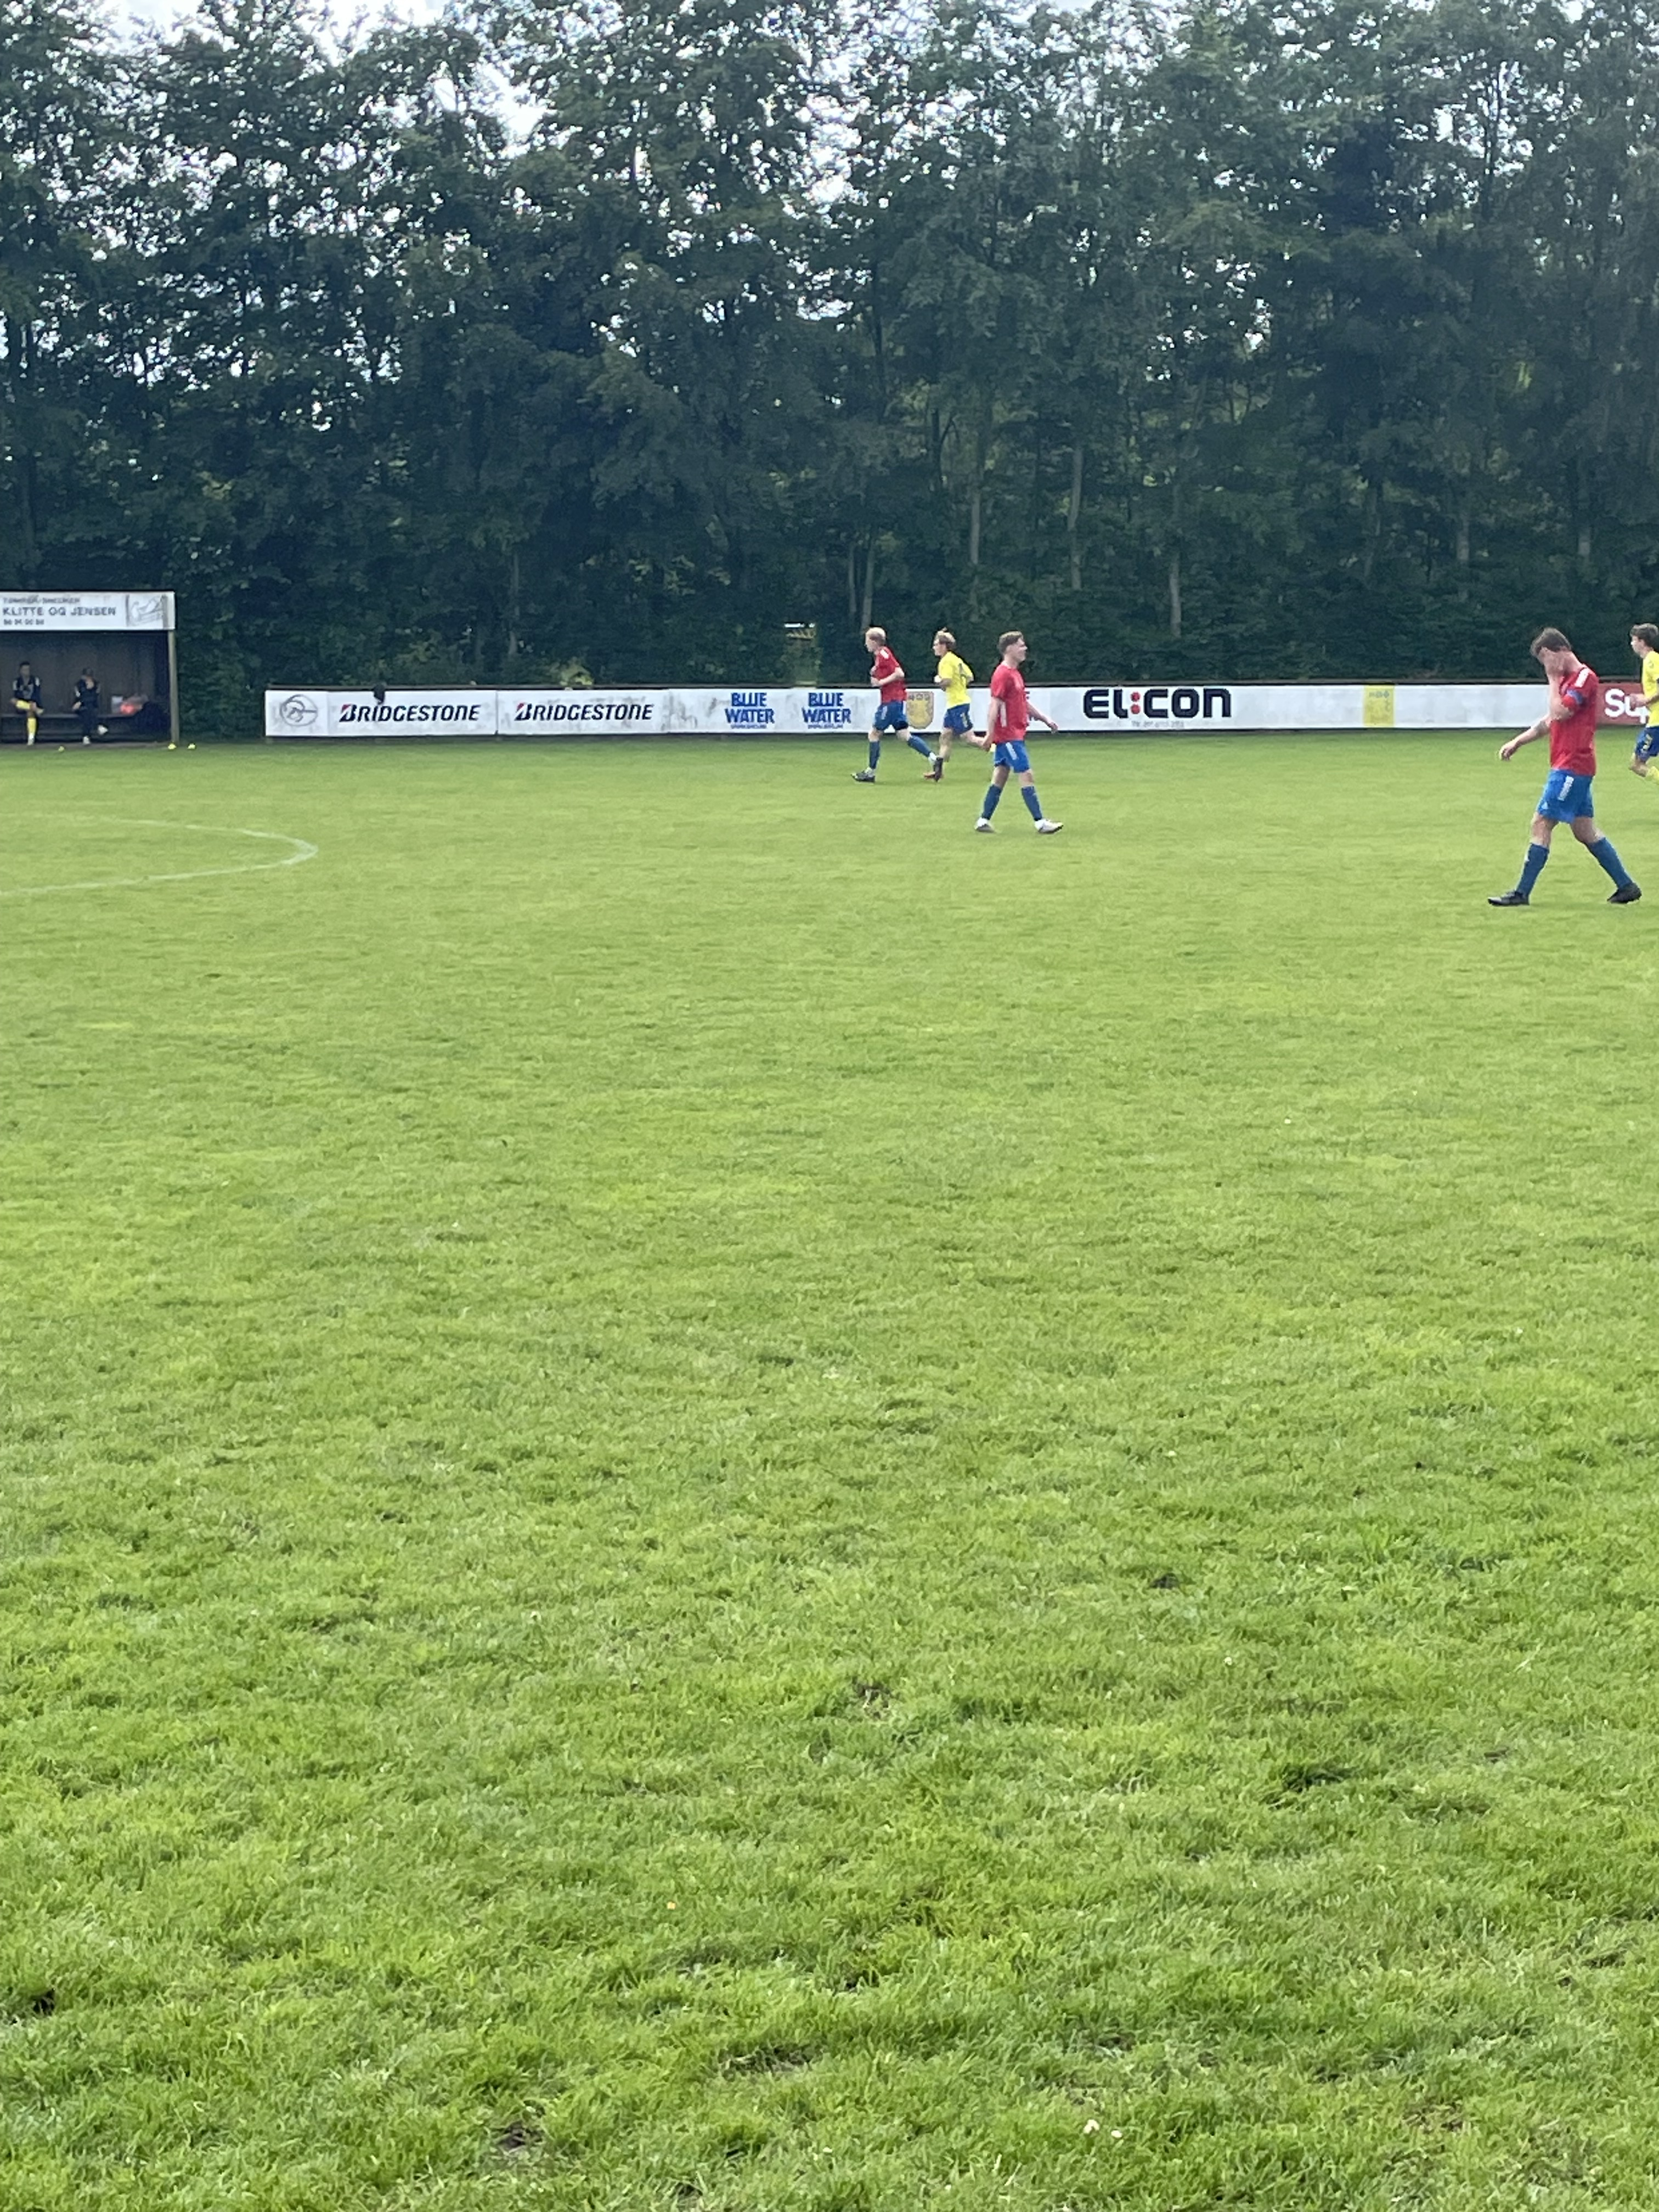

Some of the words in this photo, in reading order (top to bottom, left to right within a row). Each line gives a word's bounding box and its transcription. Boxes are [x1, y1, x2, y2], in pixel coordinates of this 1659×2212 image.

[48, 607, 66, 616] OG
[71, 607, 116, 616] JENSEN
[731, 692, 767, 707] BLUE
[808, 692, 844, 707] BLUE
[339, 704, 481, 722] BRIDGESTONE
[515, 703, 654, 721] BRIDGESTONE
[724, 708, 775, 724] WATER
[802, 707, 852, 724] WATER
